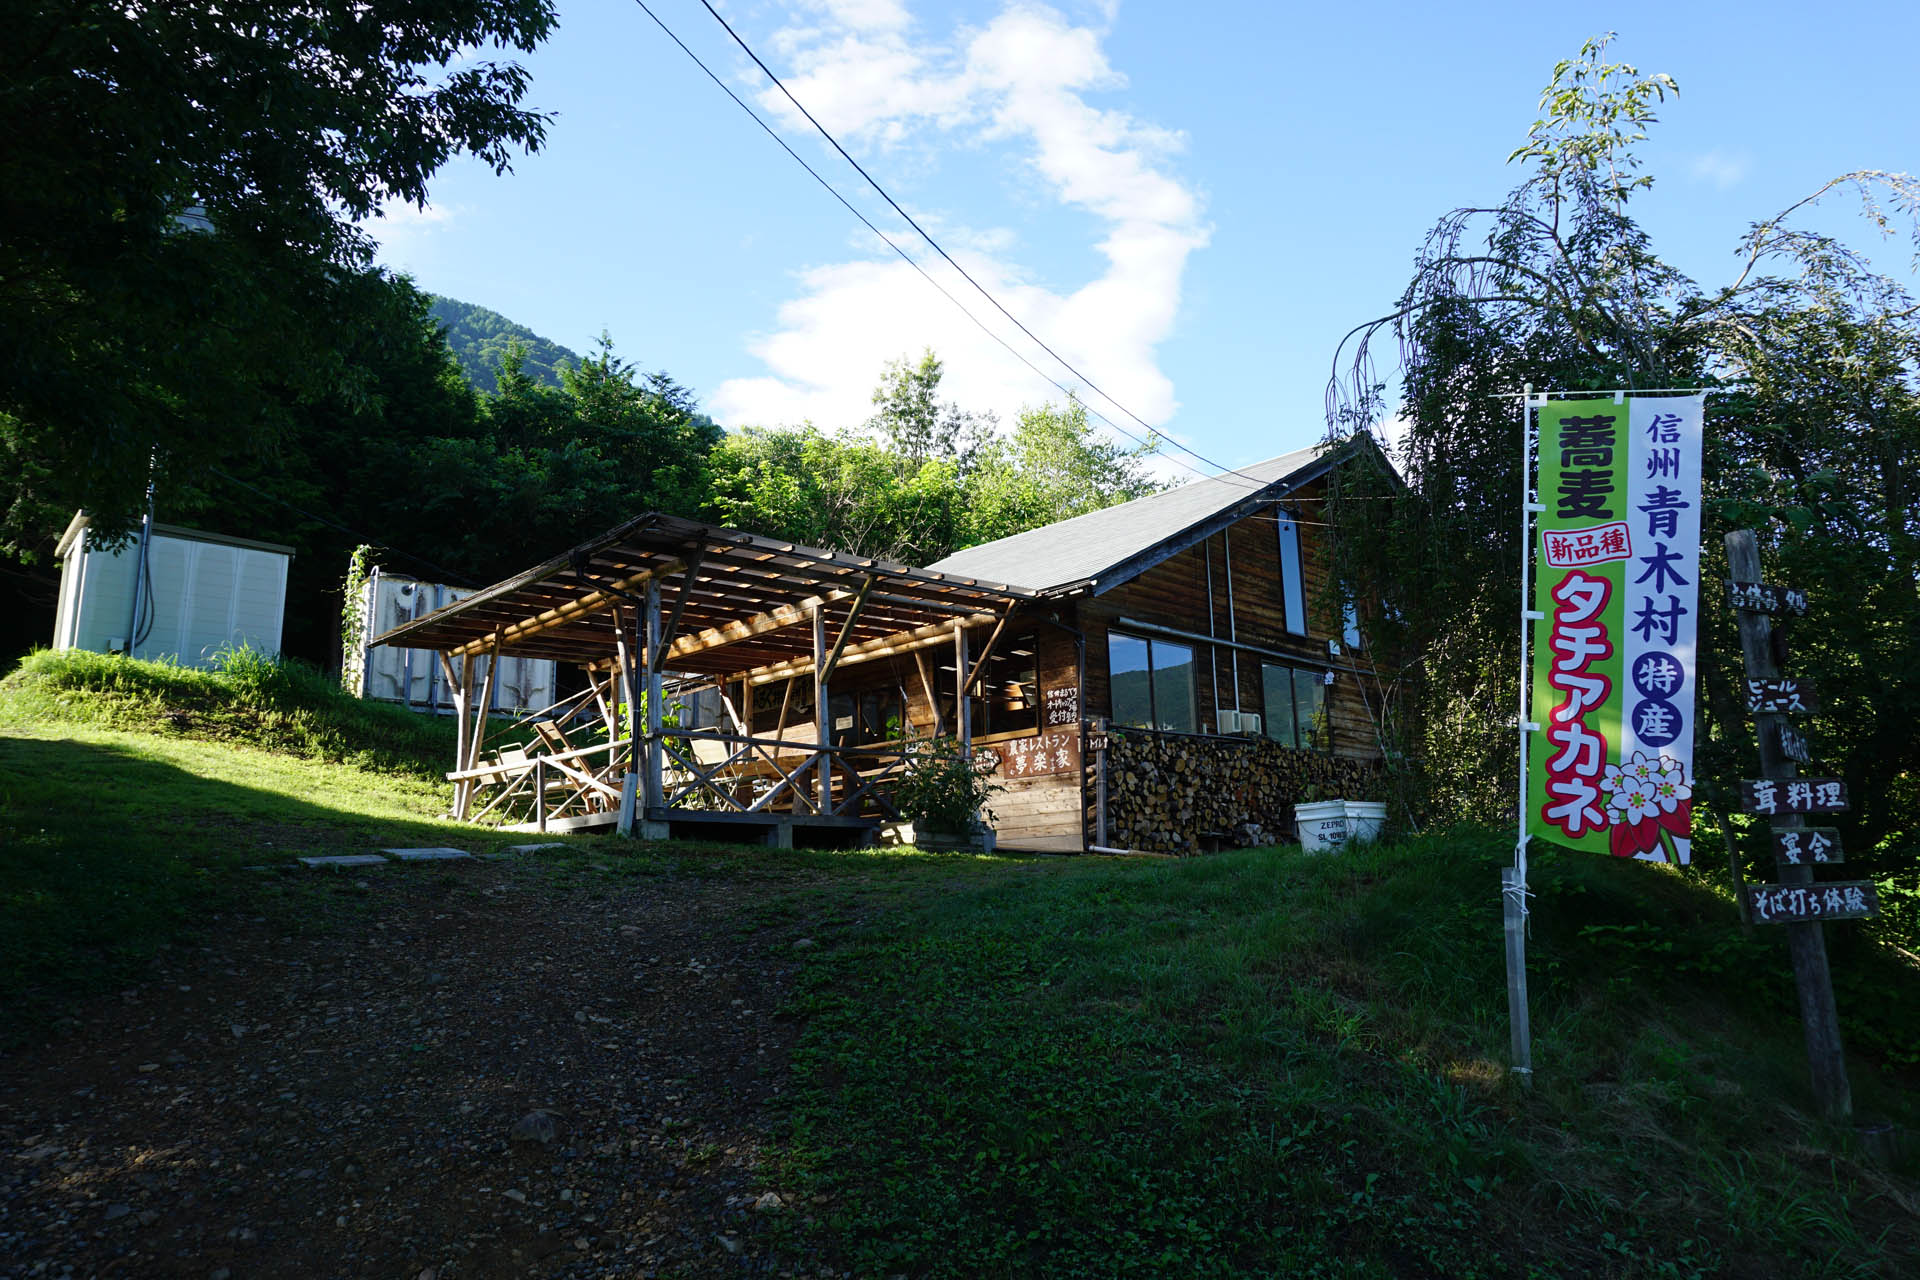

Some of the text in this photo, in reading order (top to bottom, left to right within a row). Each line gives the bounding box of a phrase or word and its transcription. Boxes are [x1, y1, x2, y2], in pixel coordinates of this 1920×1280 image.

[1557, 414, 1617, 519] 蕎麦
[1551, 528, 1628, 562] 新品種
[1632, 413, 1691, 739] 信州青木村 特産
[1748, 679, 1798, 694] ビール
[1748, 693, 1807, 712] ジュース
[1542, 570, 1613, 838] タチアカネ
[1780, 832, 1832, 864] 宴会
[1755, 886, 1868, 919] そば打ち体験
